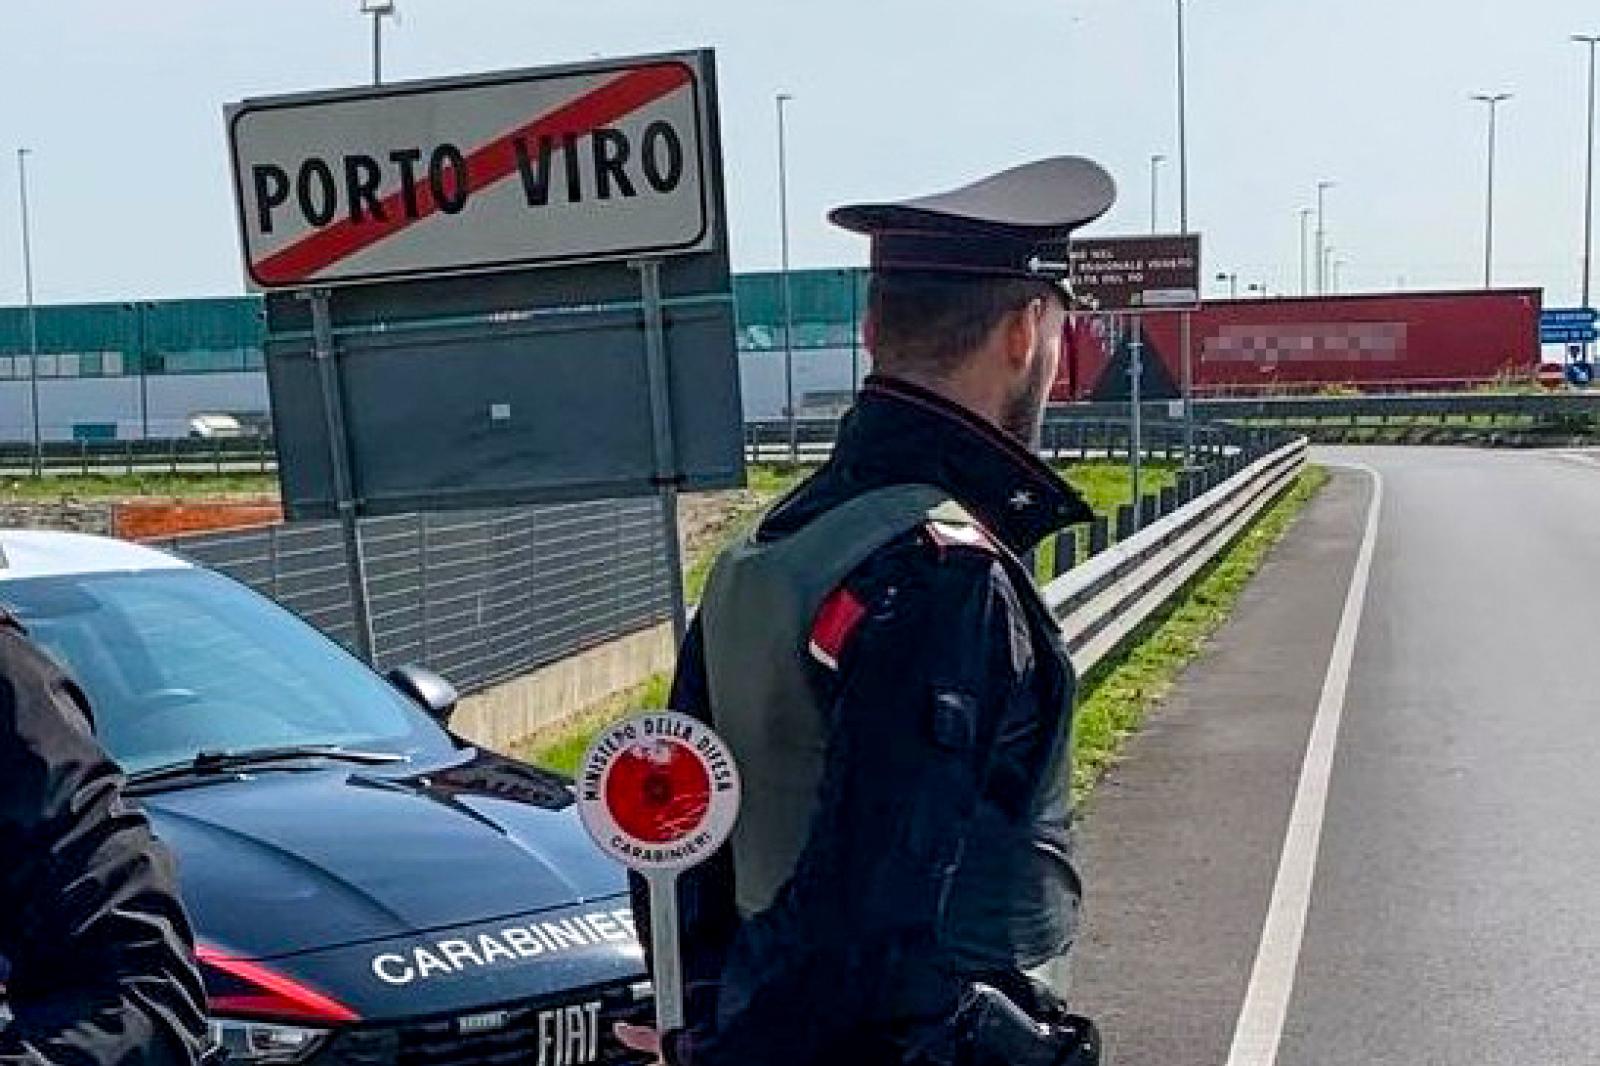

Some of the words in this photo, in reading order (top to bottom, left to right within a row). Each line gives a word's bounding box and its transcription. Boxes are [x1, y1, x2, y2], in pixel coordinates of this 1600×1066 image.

[252, 143, 468, 233] PORTO
[513, 119, 683, 207] VIRO
[644, 717, 693, 742] DELLA
[371, 908, 636, 985] CARABINIER
[538, 1001, 602, 1066] FIAT
